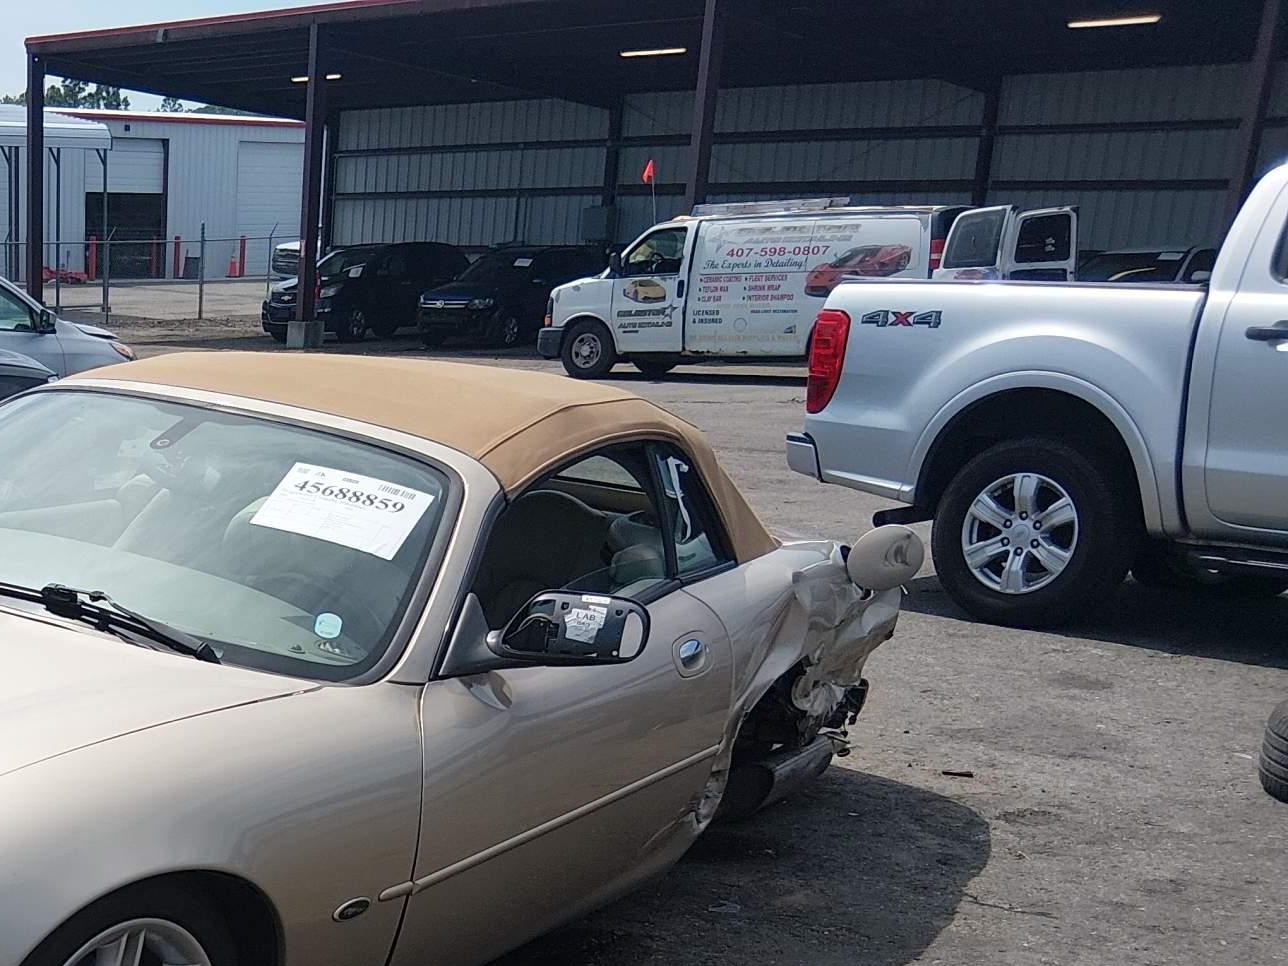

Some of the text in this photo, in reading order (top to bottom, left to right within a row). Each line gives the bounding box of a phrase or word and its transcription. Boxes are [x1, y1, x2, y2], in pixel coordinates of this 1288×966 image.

[726, 245, 830, 258] 407-598-0807
[703, 257, 808, 271] The Experts in Detailing!
[294, 479, 406, 514] 45688859
[576, 611, 596, 621] LAB
